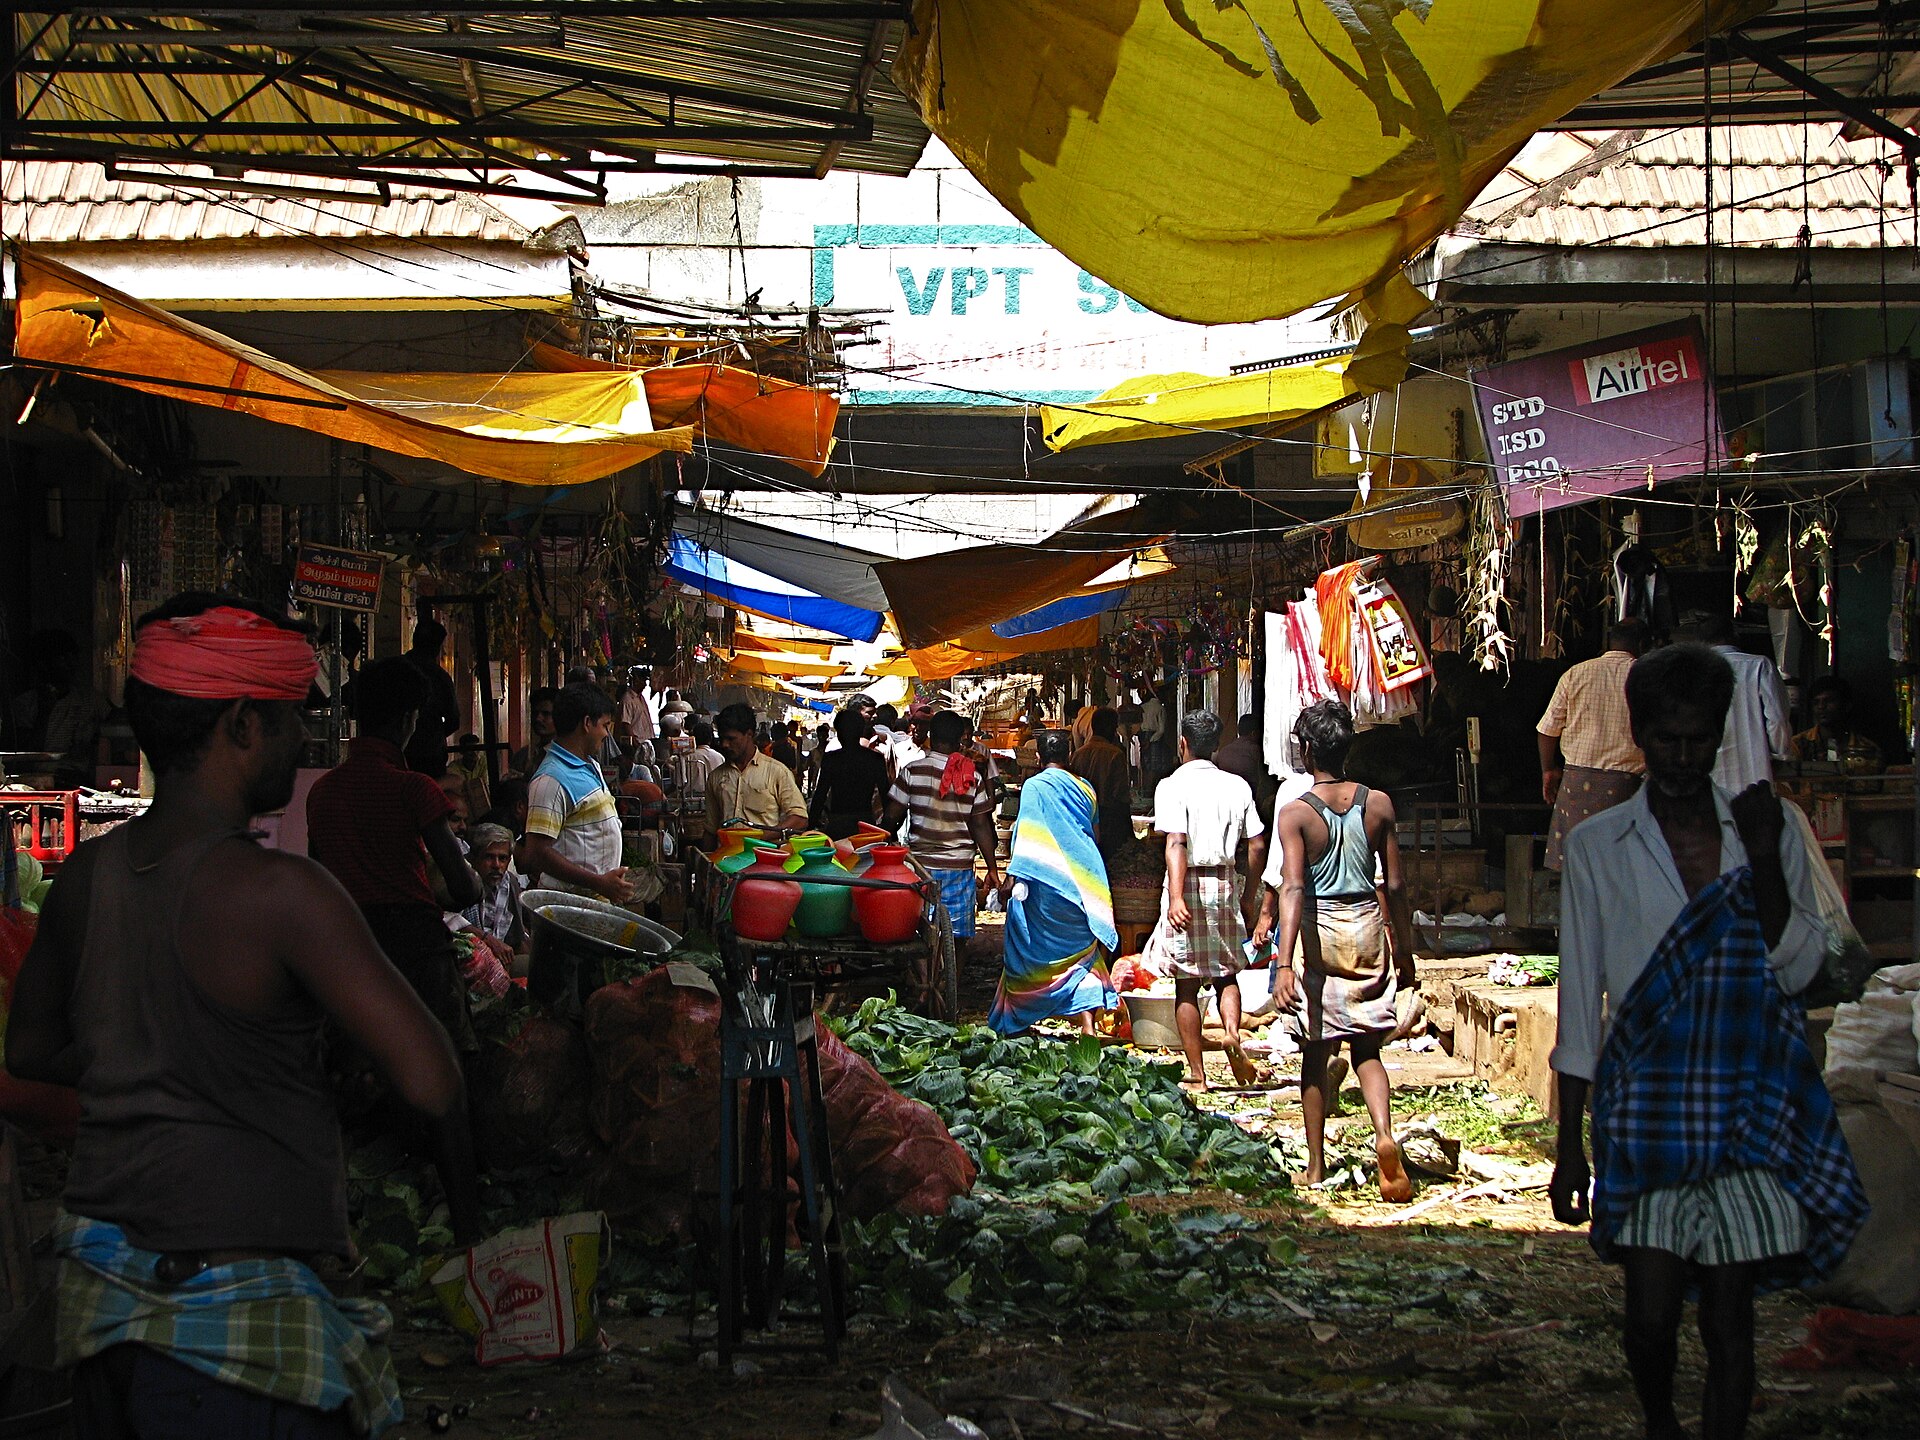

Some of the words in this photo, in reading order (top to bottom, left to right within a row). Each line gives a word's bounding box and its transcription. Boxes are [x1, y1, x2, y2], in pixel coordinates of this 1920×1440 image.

[896, 266, 1034, 316] VPT
[1076, 268, 1150, 314] S
[1595, 350, 1688, 399] Airtel
[1492, 396, 1545, 425] STD
[1498, 428, 1546, 456] ISD
[1505, 457, 1560, 485] PCO
